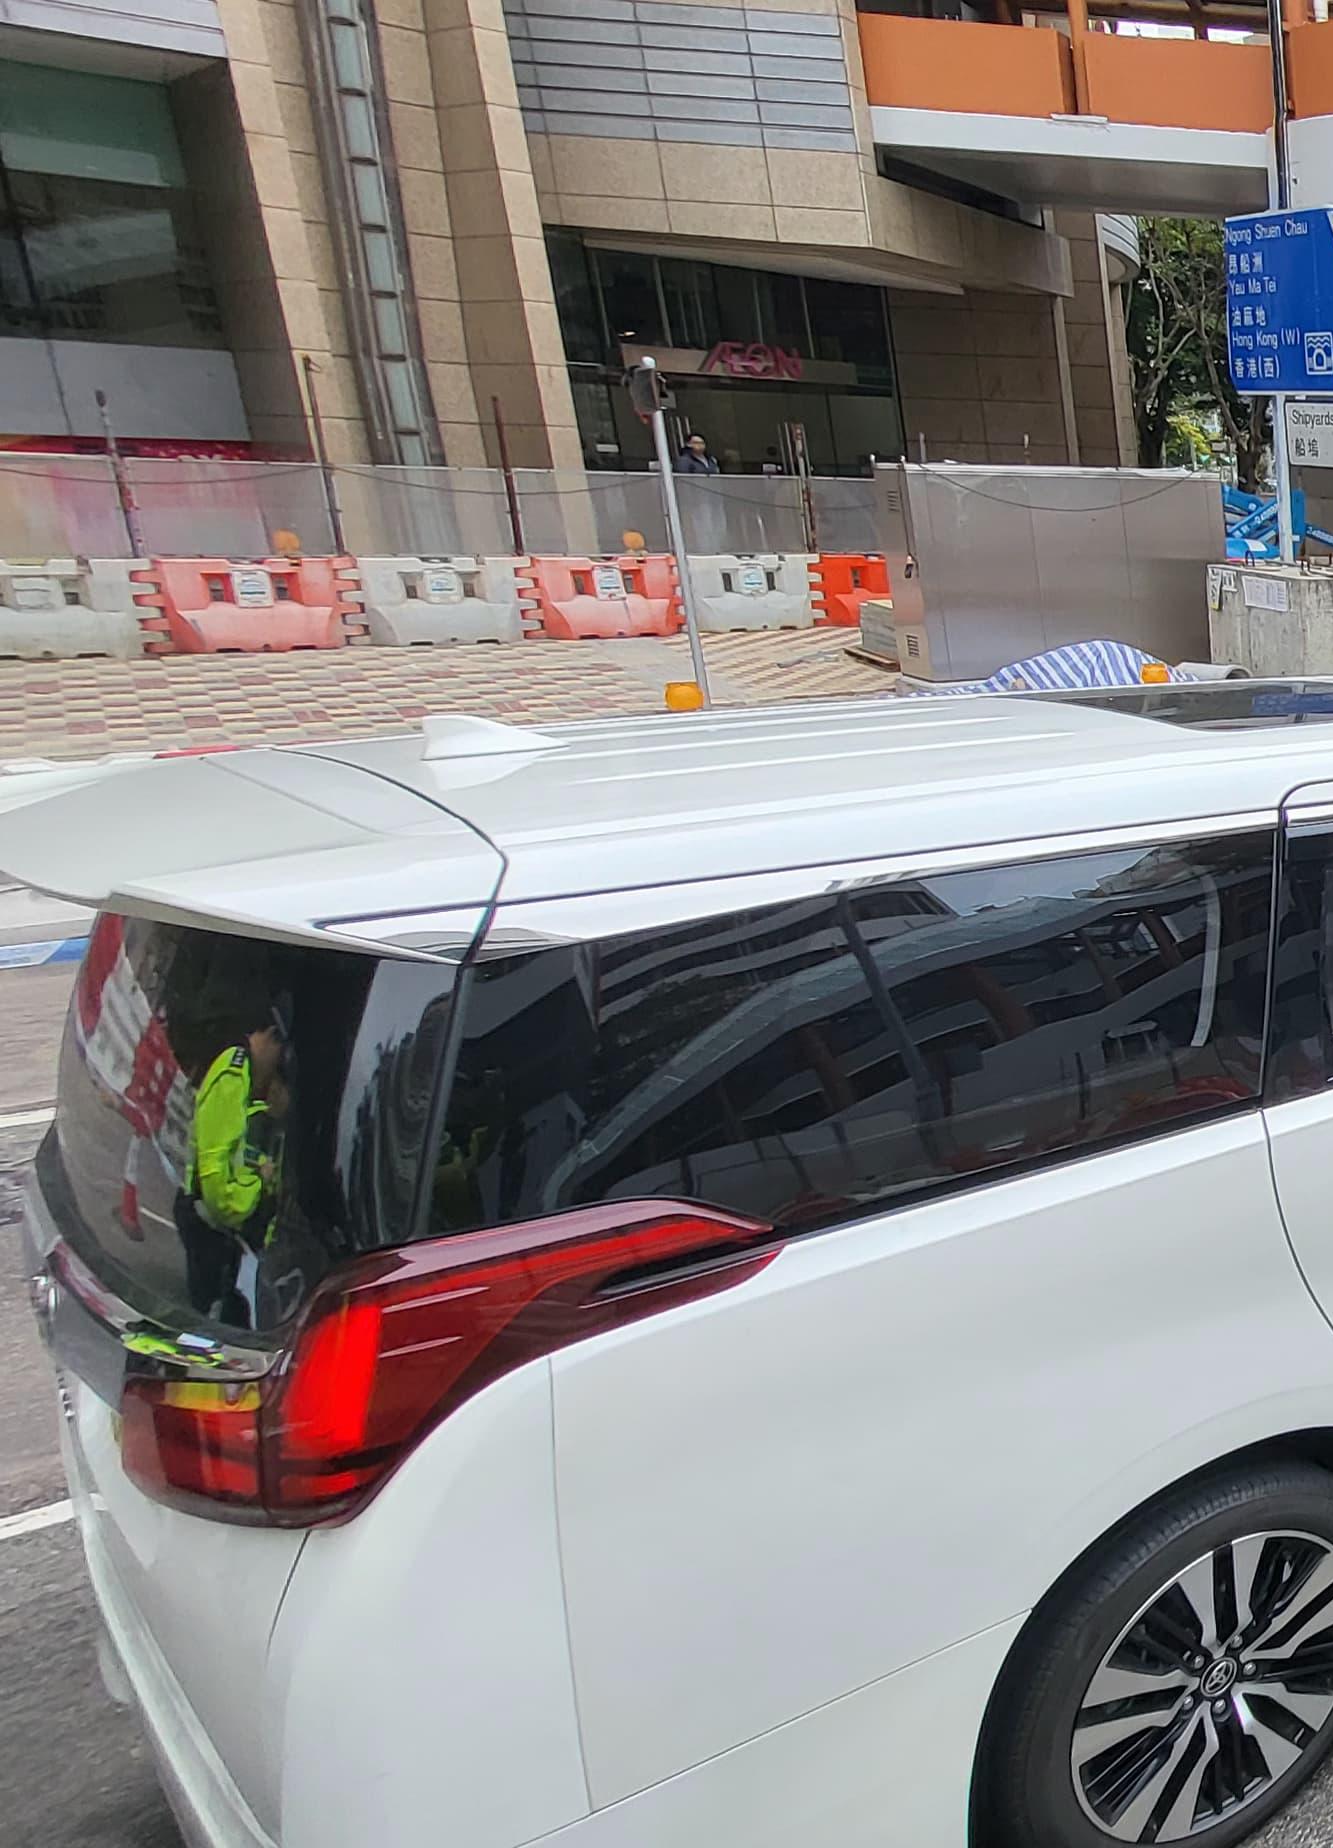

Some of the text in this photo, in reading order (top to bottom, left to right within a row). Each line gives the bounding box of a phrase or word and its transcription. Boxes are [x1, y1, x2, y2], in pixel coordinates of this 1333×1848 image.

[1225, 219, 1308, 245] Ngong Shuen Chau
[1228, 253, 1263, 275] 昂船洲
[1229, 276, 1277, 297] Yau Ma Tei
[1231, 307, 1266, 327] 油麻地
[1232, 327, 1300, 350] Hong Kong (W)
[1235, 355, 1280, 379] 香港(西)
[1295, 438, 1319, 457] 船塢
